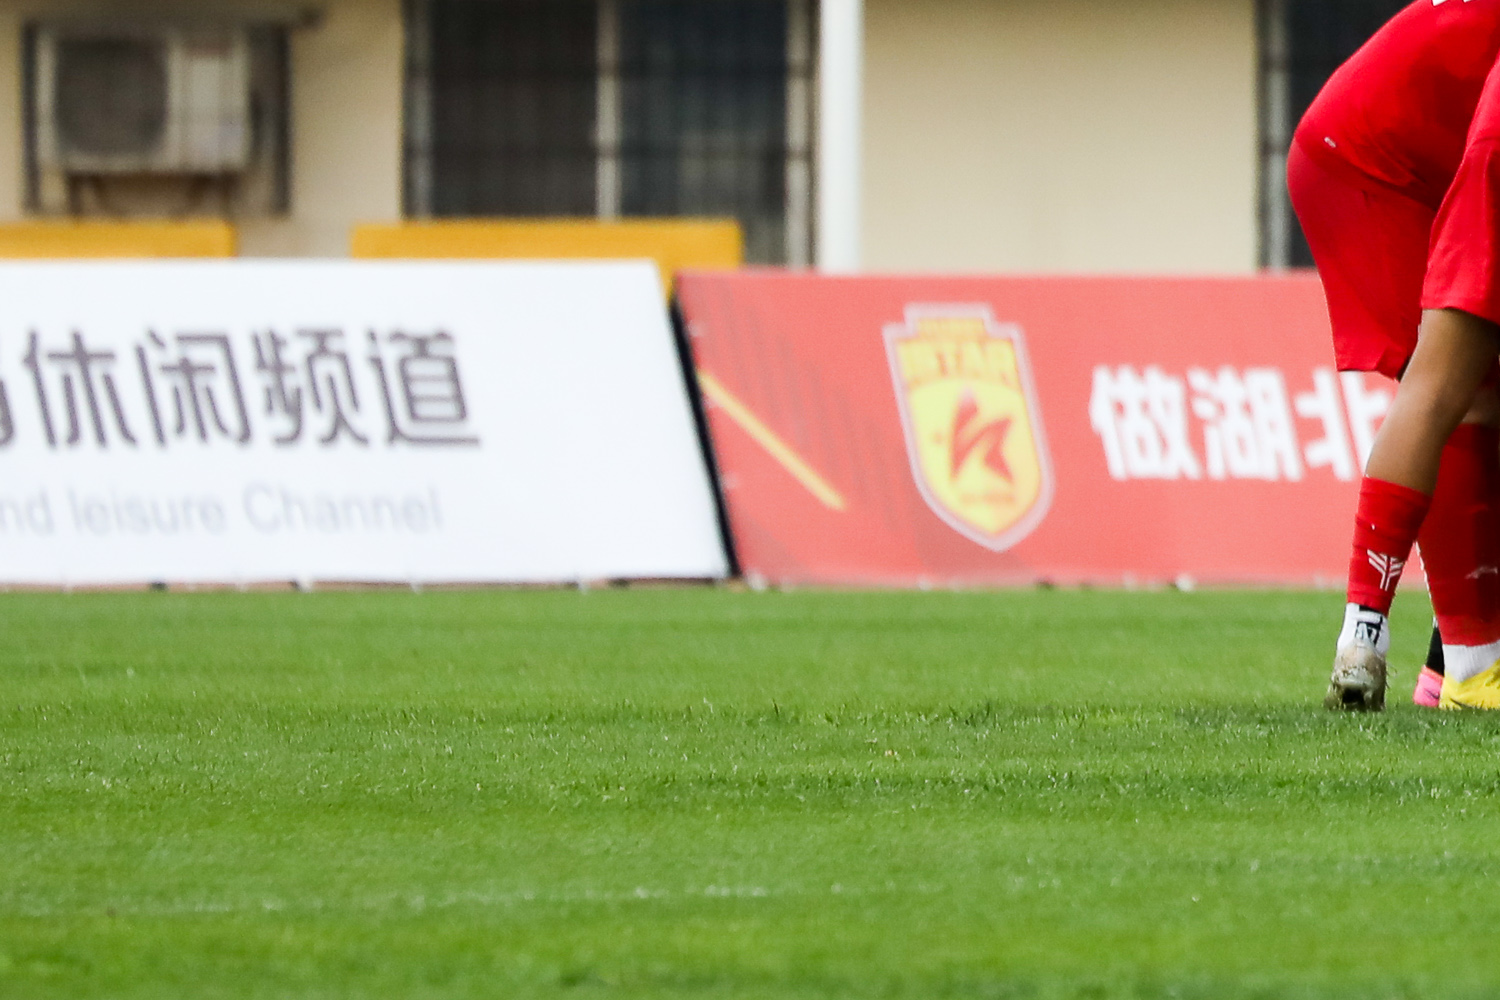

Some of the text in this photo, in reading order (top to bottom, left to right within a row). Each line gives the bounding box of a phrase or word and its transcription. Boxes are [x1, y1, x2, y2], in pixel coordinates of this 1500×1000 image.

[0, 328, 482, 450] 休闲频道
[66, 486, 228, 536] leisure
[241, 482, 446, 536] Channel
